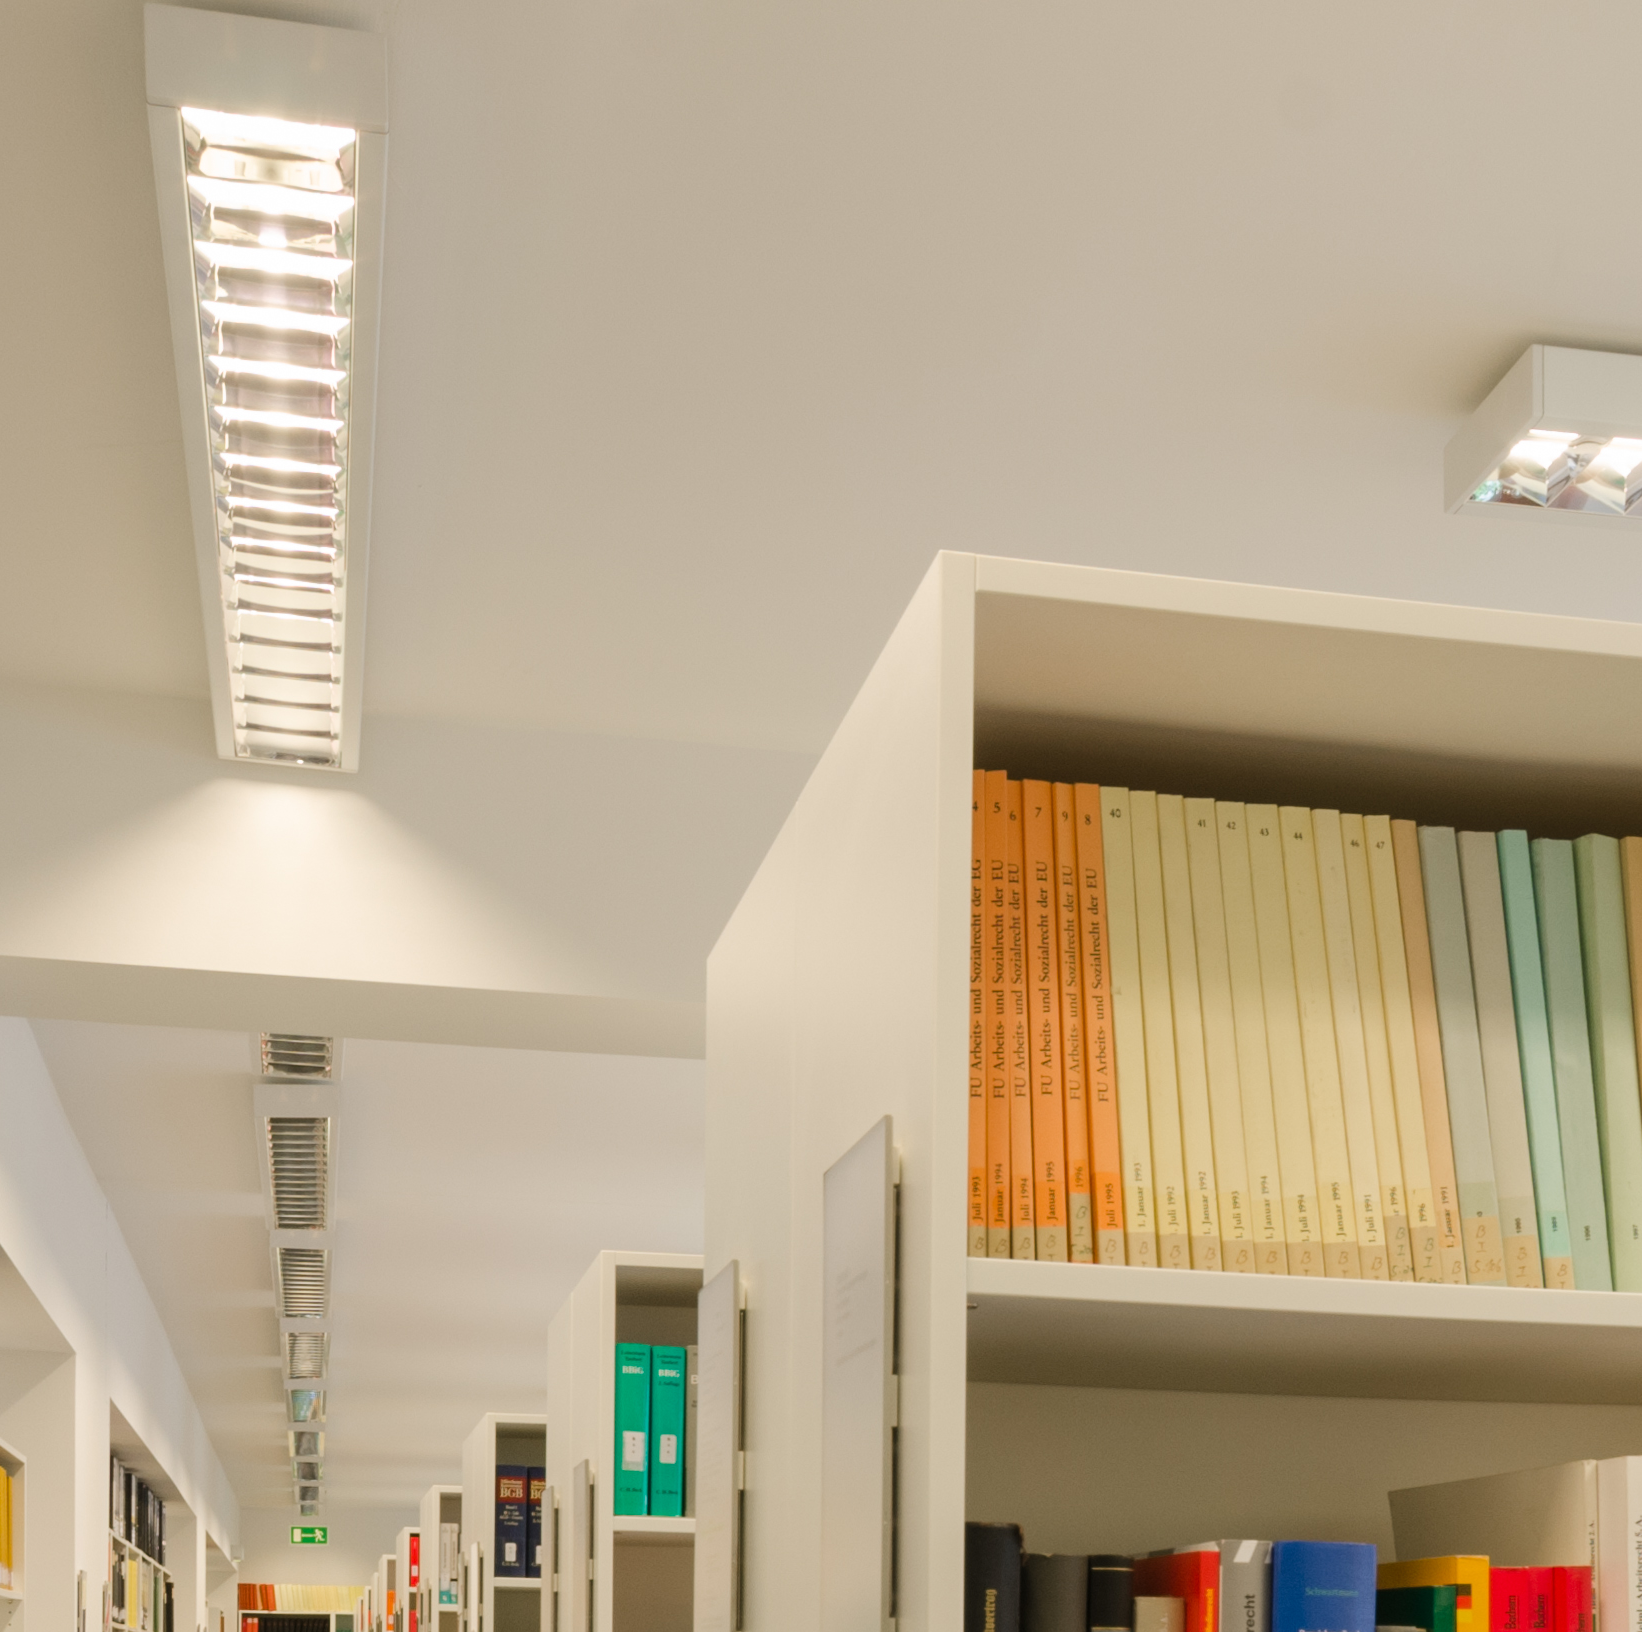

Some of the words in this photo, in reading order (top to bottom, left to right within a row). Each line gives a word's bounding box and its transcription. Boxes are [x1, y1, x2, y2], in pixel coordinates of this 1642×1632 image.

[1035, 807, 1042, 818] 7
[991, 859, 1004, 880] EU
[1036, 861, 1048, 883] EU
[991, 887, 1004, 908] der
[1036, 887, 1048, 908] der
[992, 914, 1005, 984] Sozialrecht
[1037, 914, 1051, 984] Sozialrecht
[996, 989, 1005, 1016] und
[1042, 988, 1051, 1014] und
[992, 1021, 1005, 1071] Arbeits-
[1039, 1018, 1052, 1070] Arbeits-
[993, 1078, 1005, 1099] FU
[1040, 1074, 1053, 1096] FU
[1046, 1160, 1055, 1182] 1995
